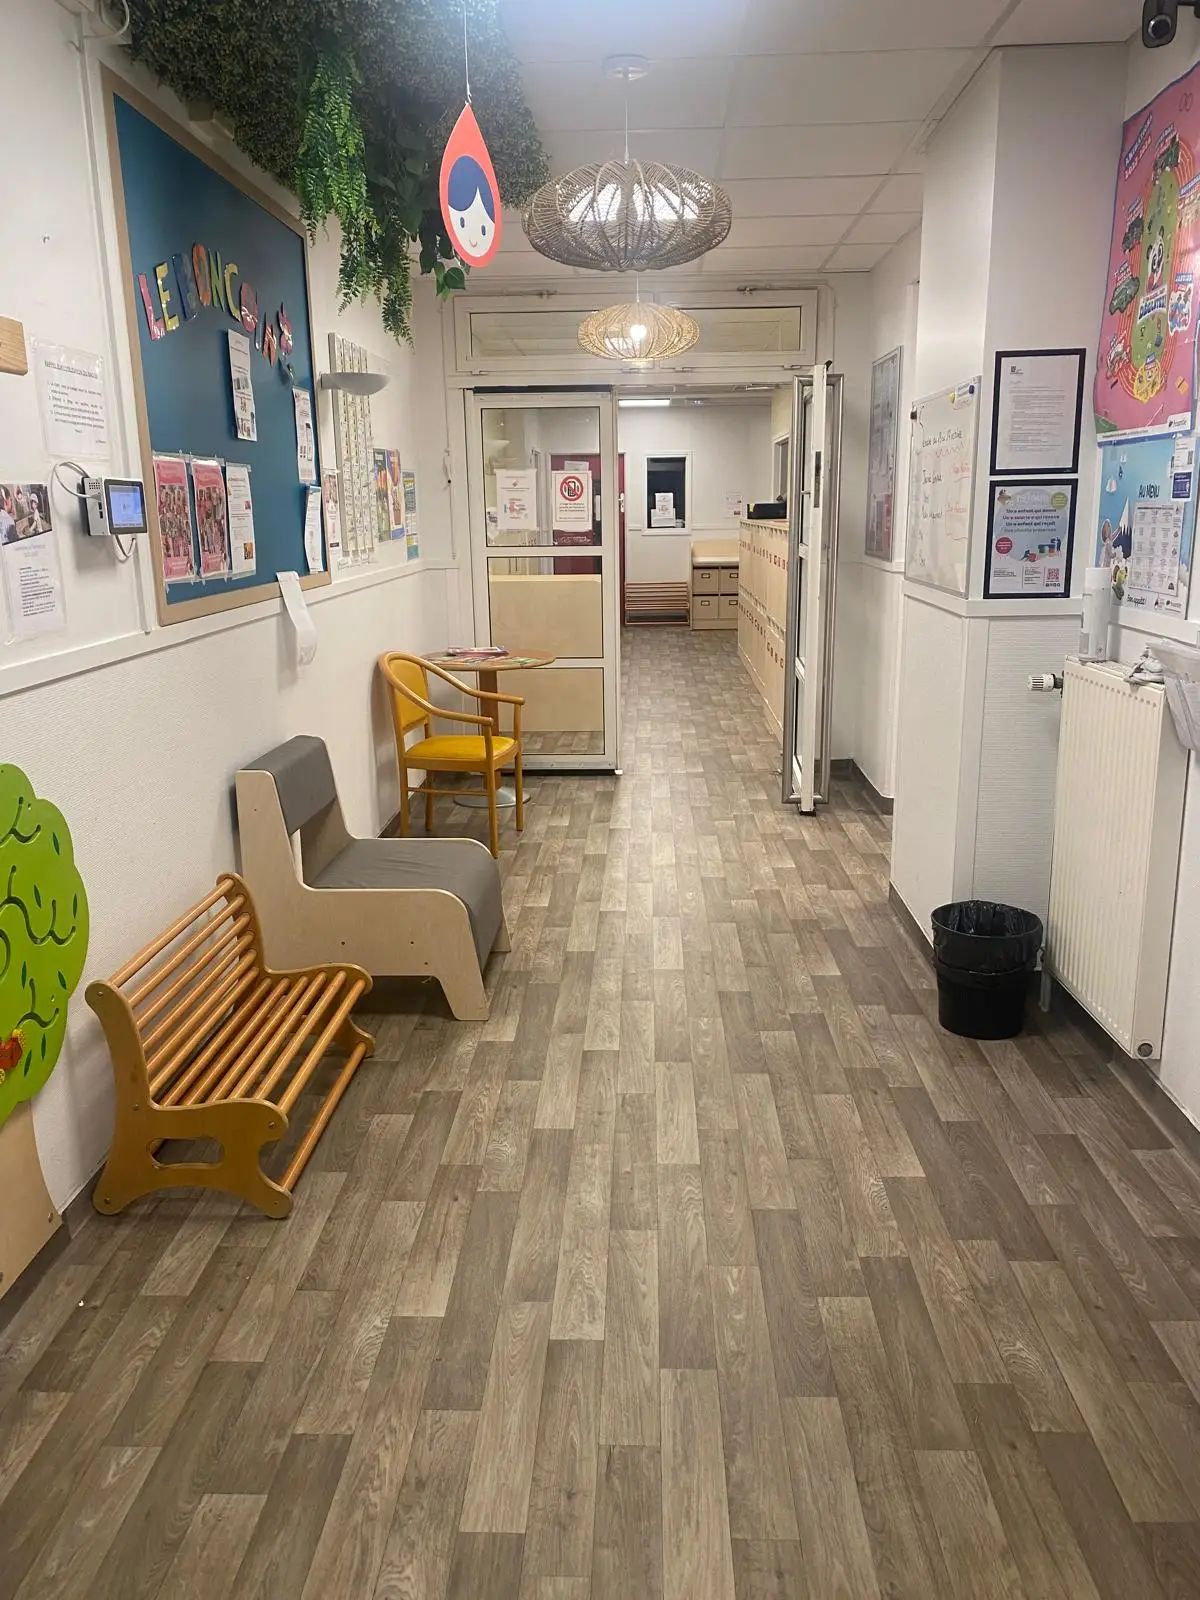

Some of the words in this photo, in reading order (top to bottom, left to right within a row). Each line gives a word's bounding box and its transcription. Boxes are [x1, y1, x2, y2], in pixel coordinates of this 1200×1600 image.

[137, 261, 180, 341] LE
[1138, 484, 1146, 499] AU
[1146, 483, 1160, 499] MENU
